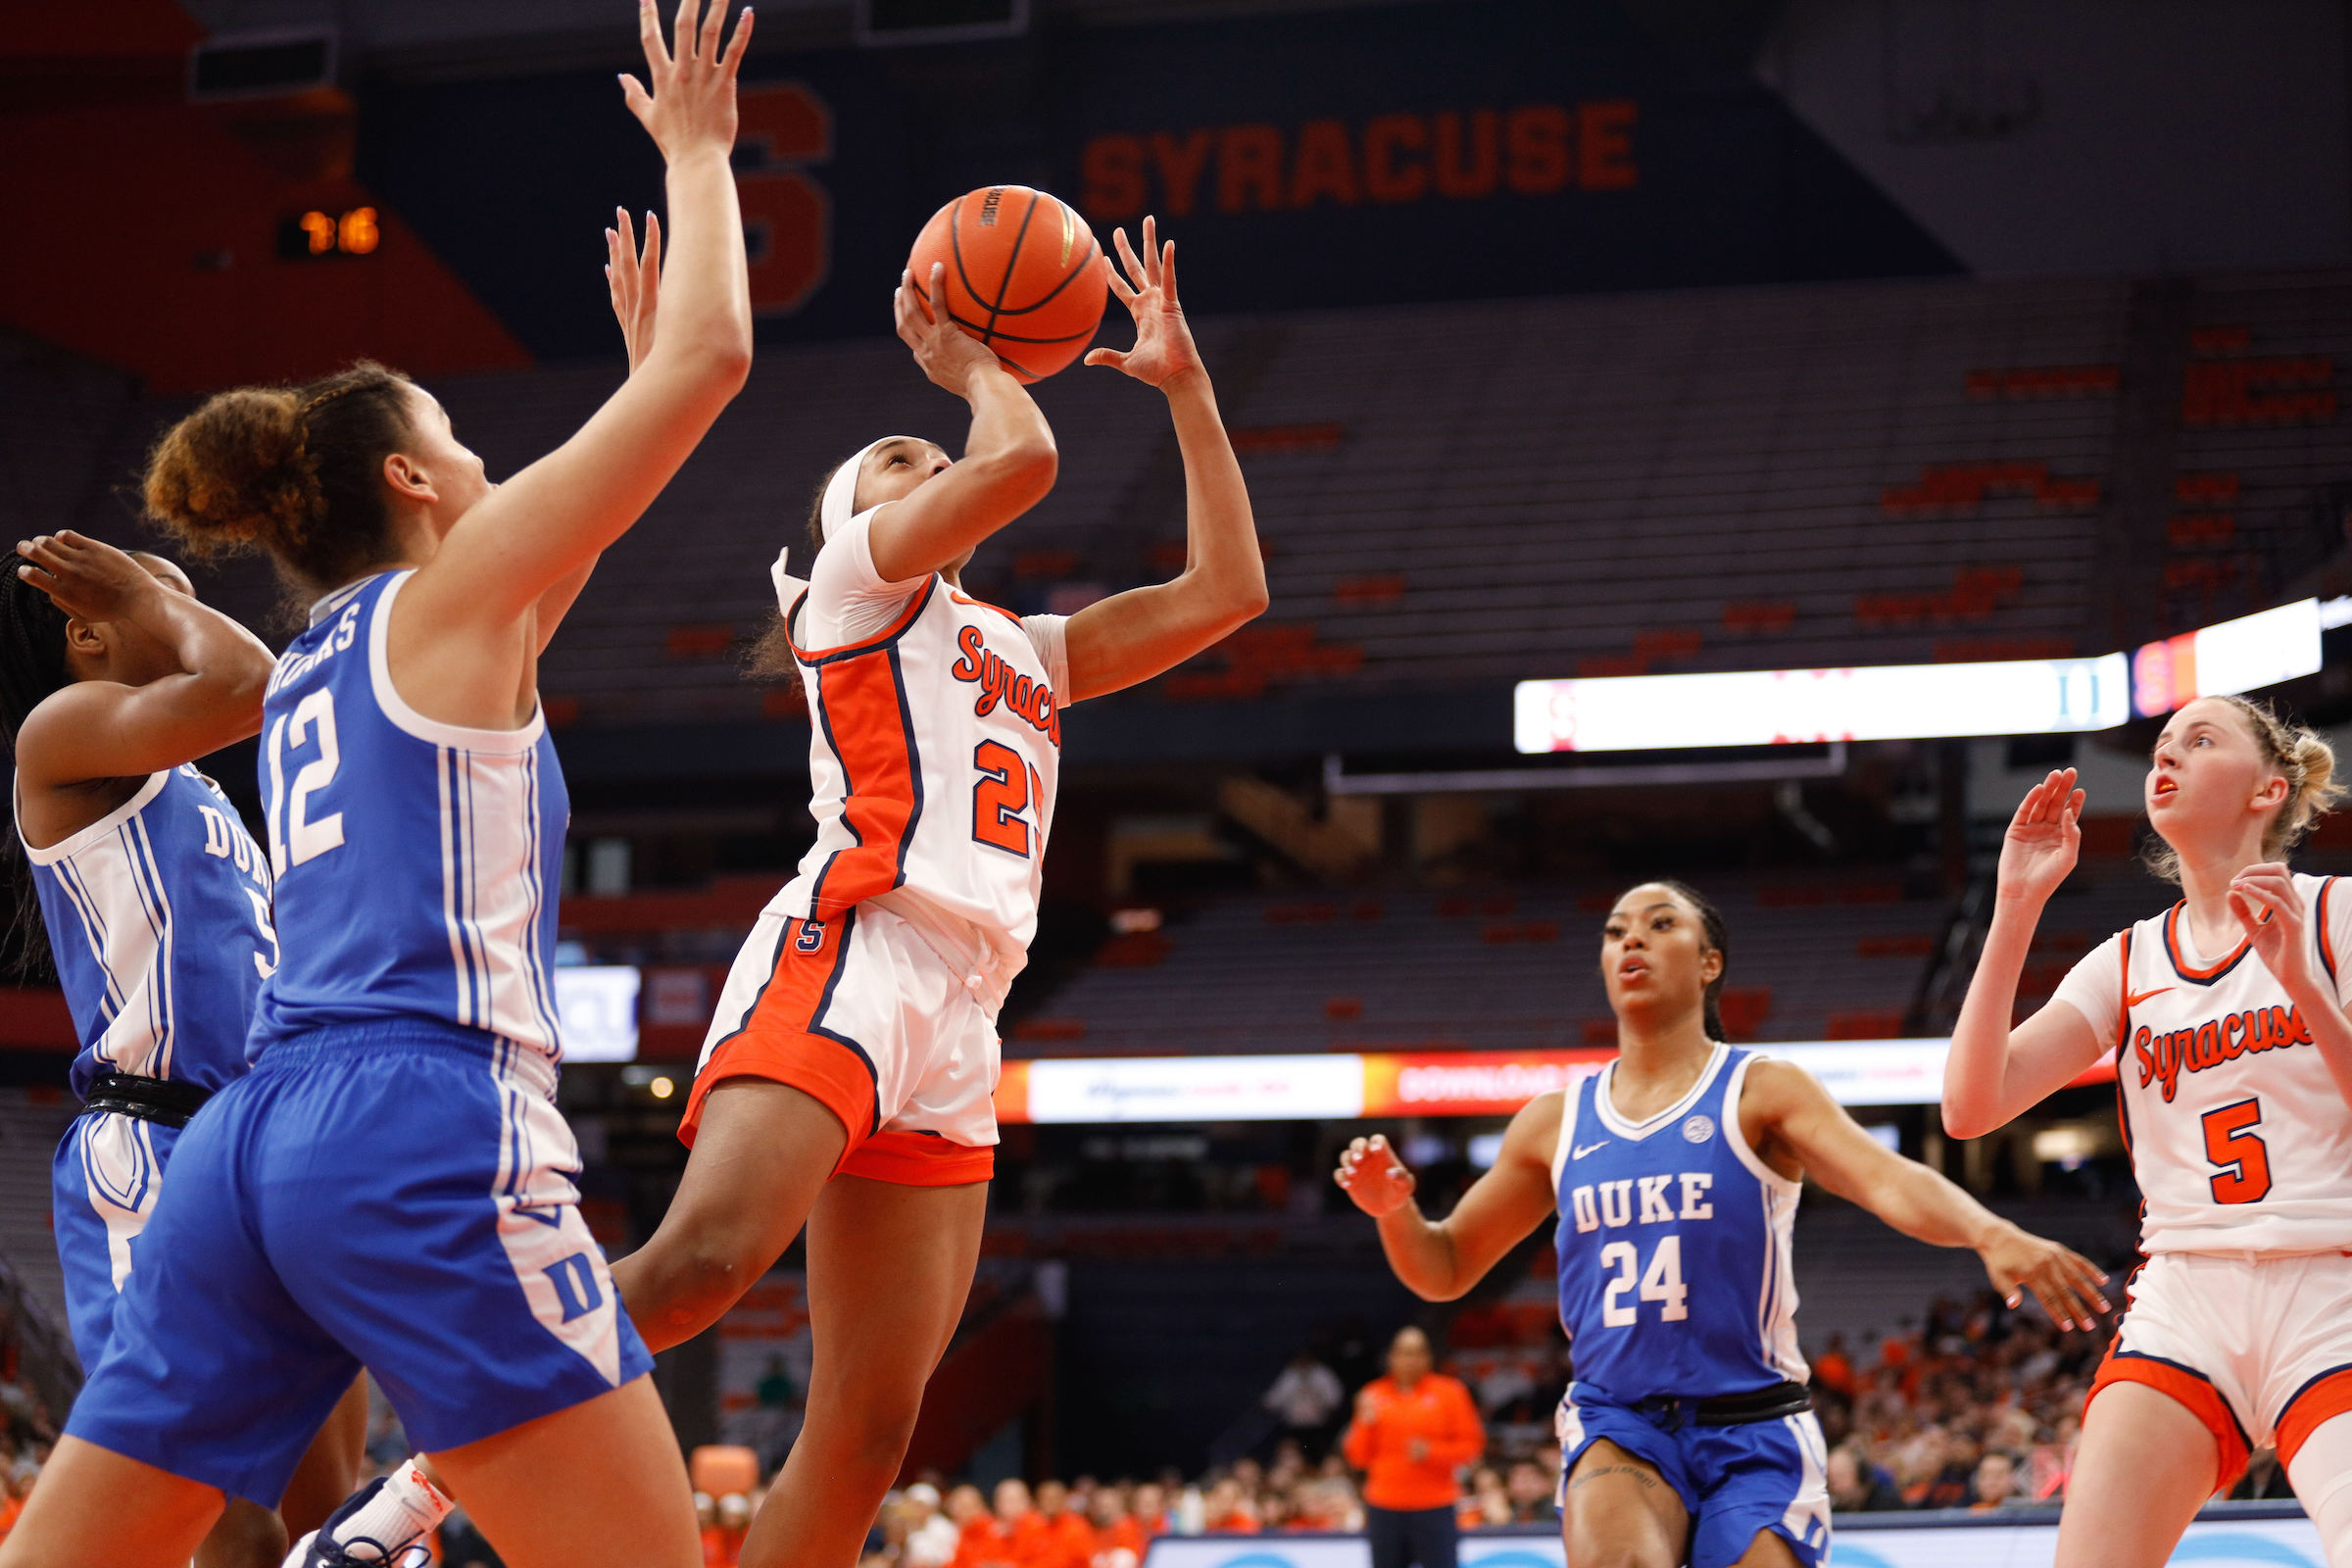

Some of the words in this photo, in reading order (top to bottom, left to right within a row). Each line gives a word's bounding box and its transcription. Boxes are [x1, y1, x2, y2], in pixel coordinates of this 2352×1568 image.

[1082, 102, 1639, 220] SYRACUSE
[952, 624, 1060, 749] Syracu
[268, 687, 345, 882] 12
[197, 805, 273, 906] DUK
[796, 918, 826, 952] S
[2201, 1097, 2273, 1205] 5
[1572, 1173, 1714, 1234] DUKE
[541, 1251, 604, 1324] D
[1600, 1235, 1689, 1328] 24
